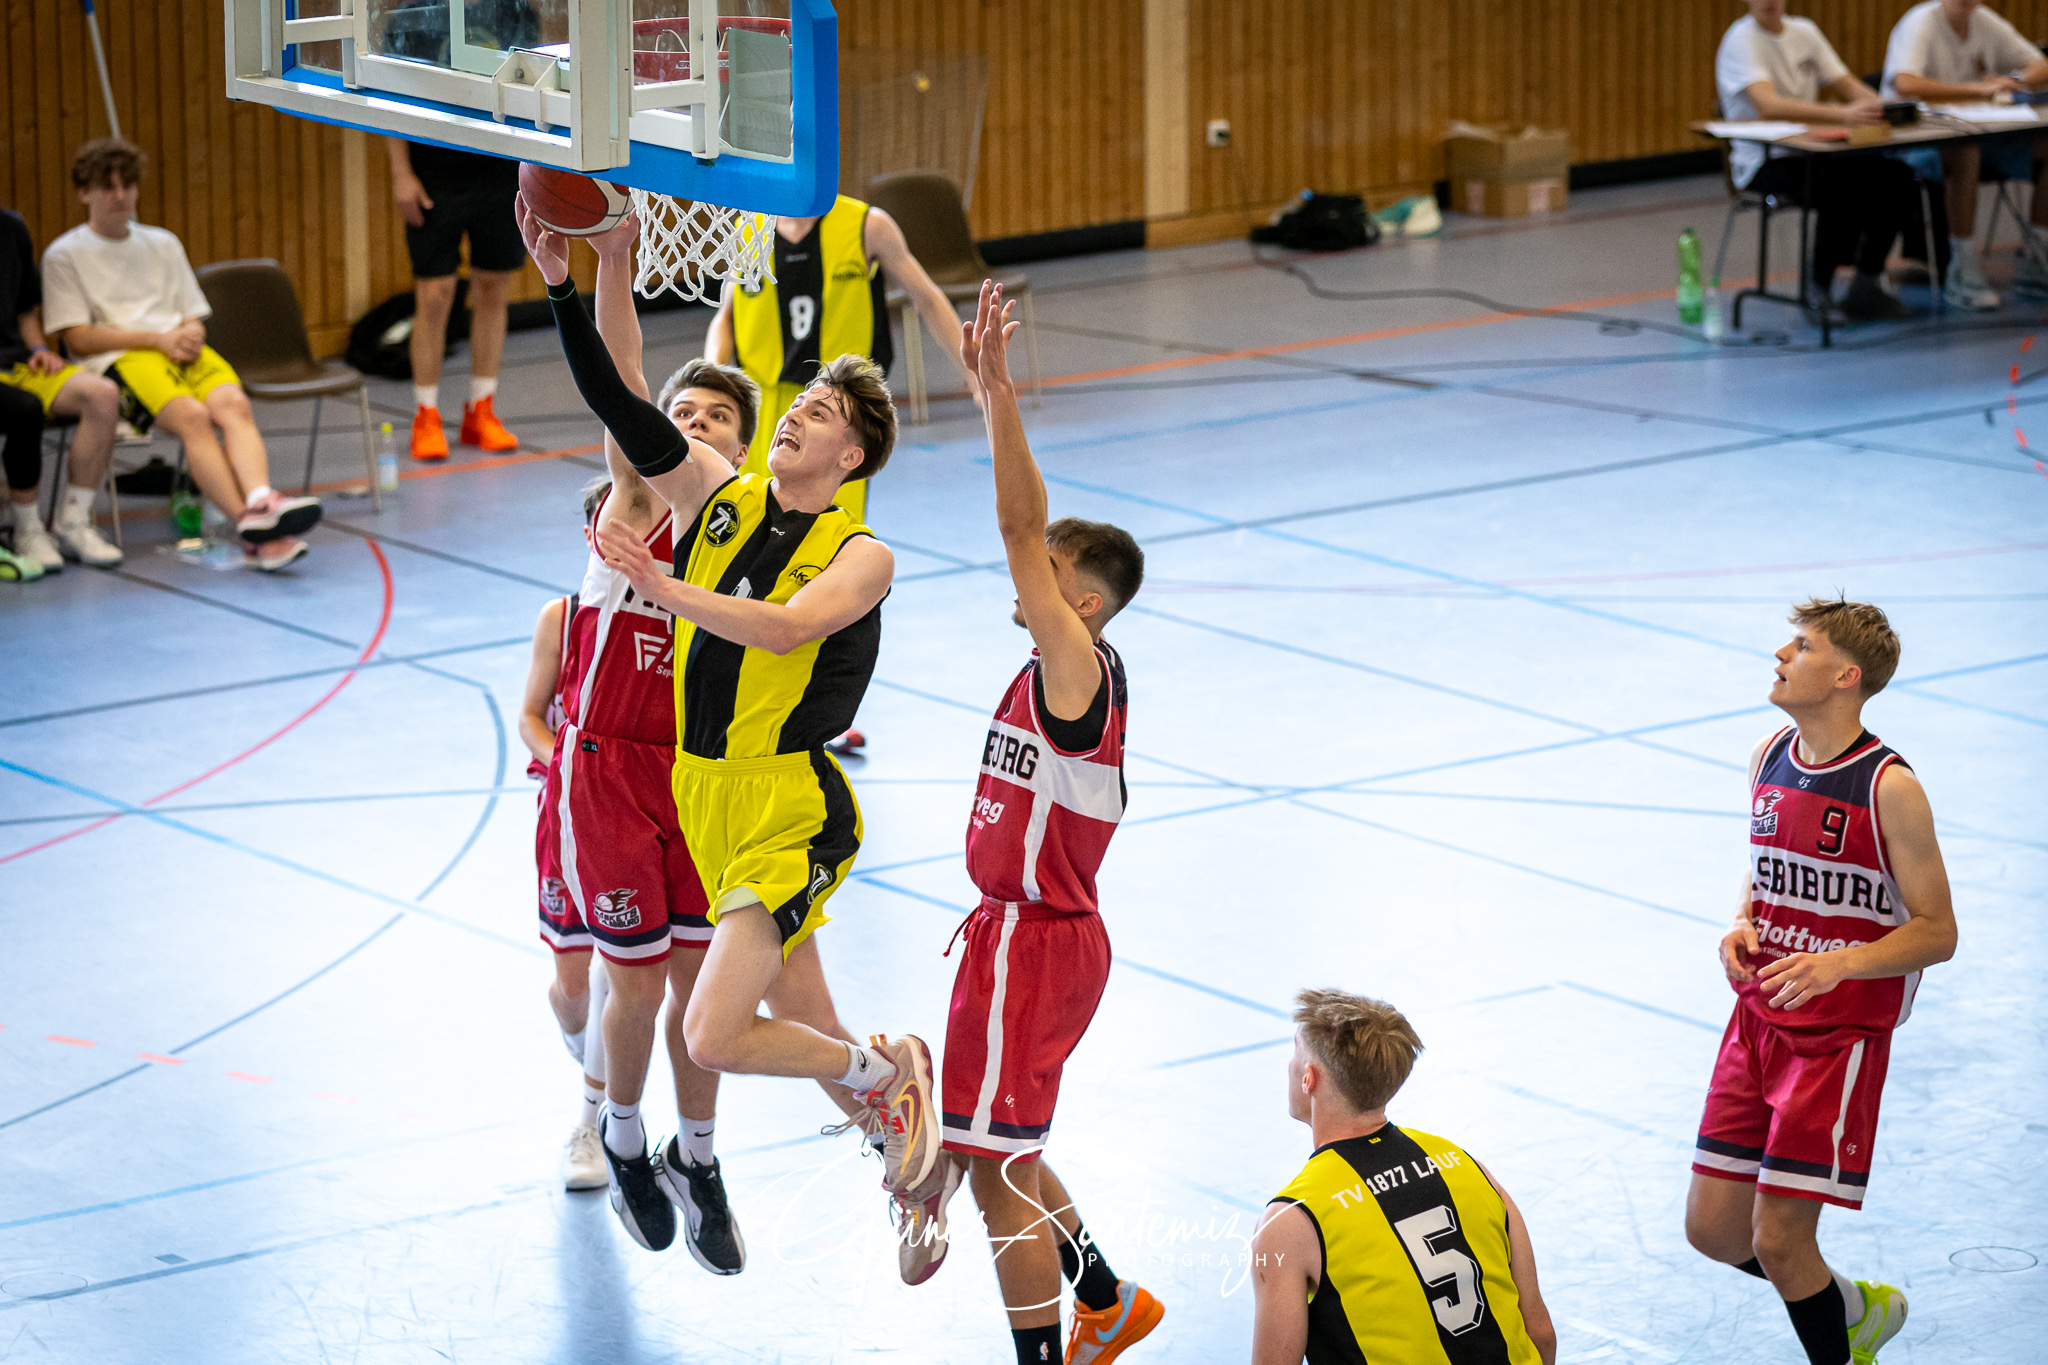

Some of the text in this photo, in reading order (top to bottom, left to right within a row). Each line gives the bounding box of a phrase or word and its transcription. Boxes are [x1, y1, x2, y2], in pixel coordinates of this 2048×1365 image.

[789, 295, 815, 341] 8
[1816, 805, 1849, 857] 9
[1751, 856, 1894, 915] SBIBURG
[1331, 1151, 1461, 1209] TV 1877 LAUF
[1394, 1204, 1485, 1336] 5
